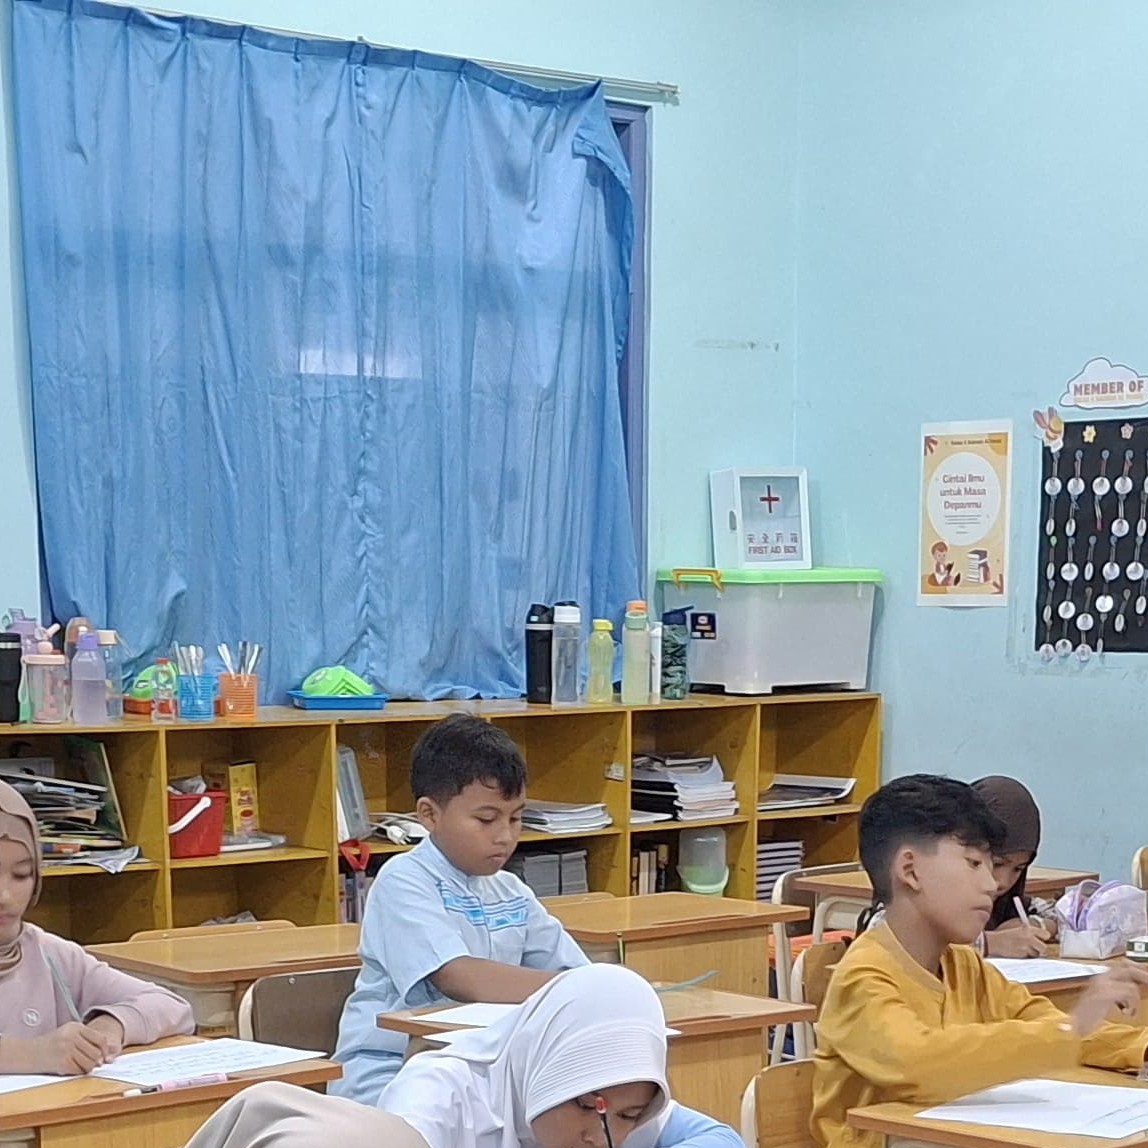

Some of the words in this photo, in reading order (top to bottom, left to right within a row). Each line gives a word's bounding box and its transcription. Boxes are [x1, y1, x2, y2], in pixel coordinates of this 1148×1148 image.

[1073, 382, 1124, 396] MEMBER
[1128, 380, 1145, 393] OF
[940, 486, 963, 497] untuk
[963, 486, 987, 497] Masa
[944, 500, 982, 511] Depanmu
[748, 546, 768, 555] FIRST
[770, 545, 782, 554] AID
